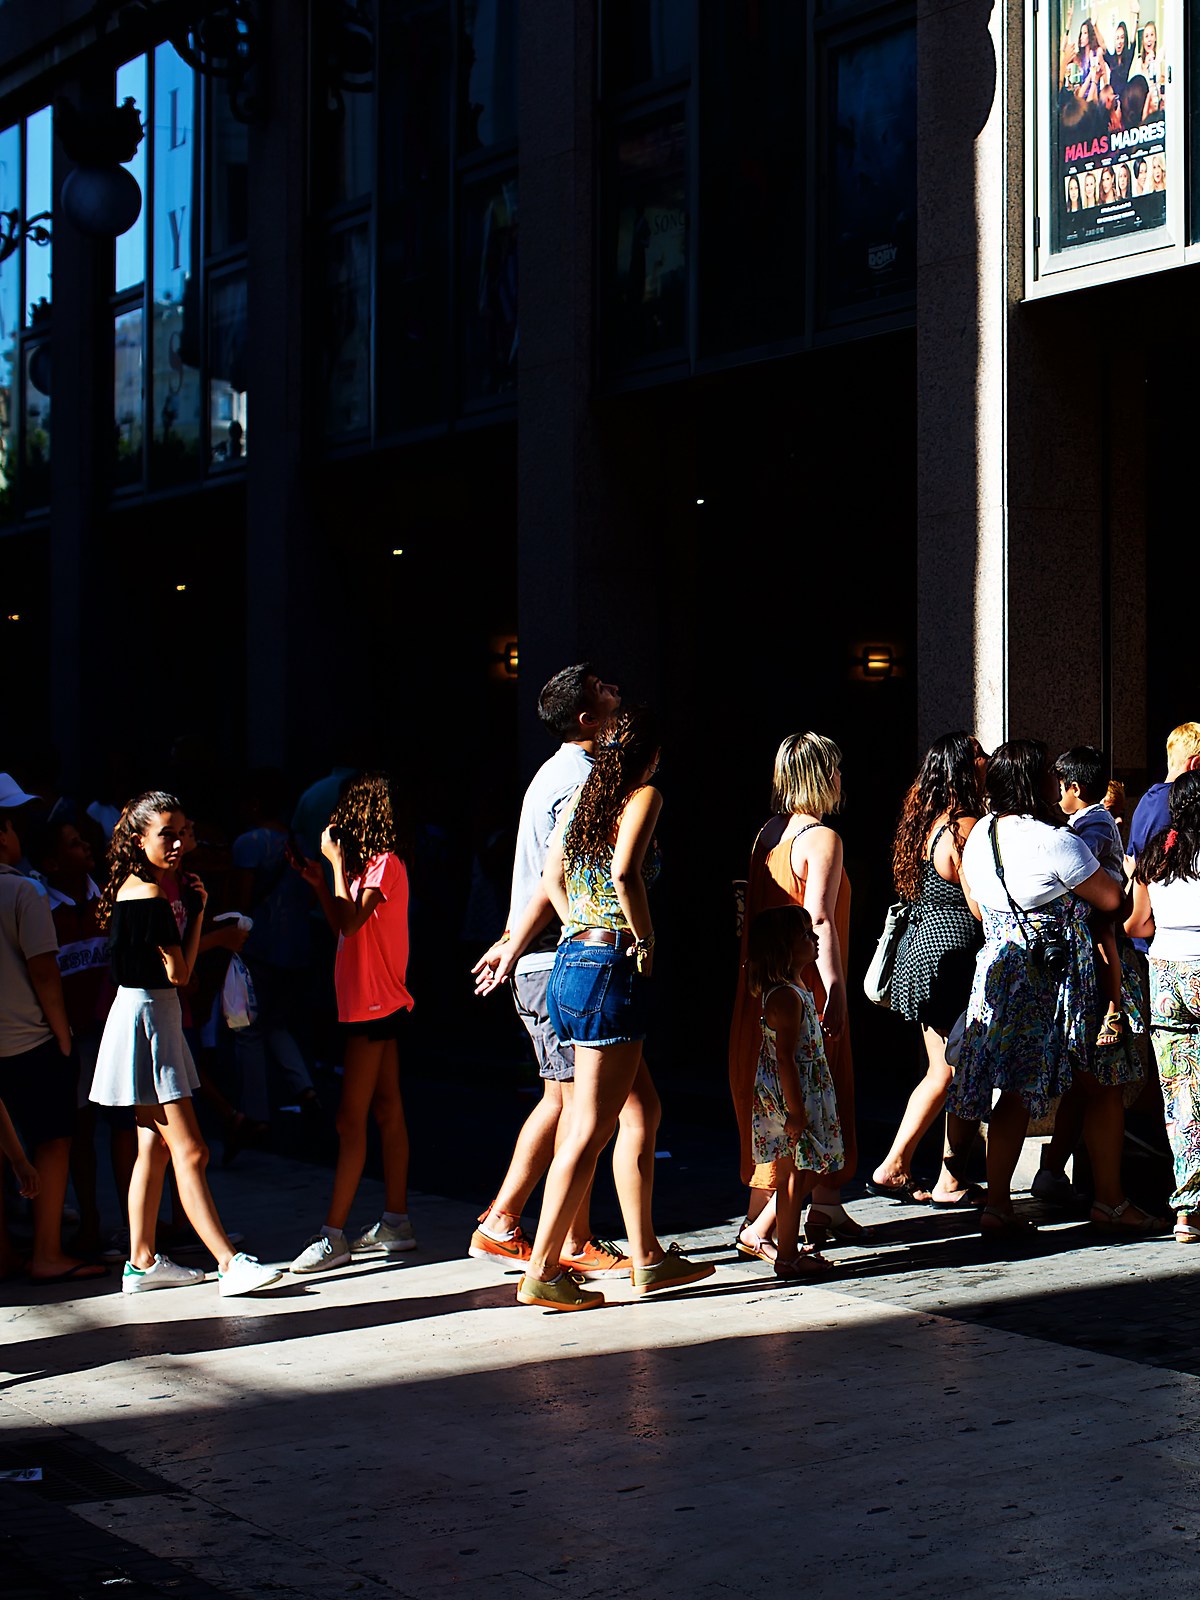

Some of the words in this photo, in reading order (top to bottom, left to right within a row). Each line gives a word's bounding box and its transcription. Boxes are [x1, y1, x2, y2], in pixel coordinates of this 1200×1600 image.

[1064, 135, 1109, 163] MALAS
[1110, 120, 1166, 152] MADRES
[868, 247, 897, 266] DORY
